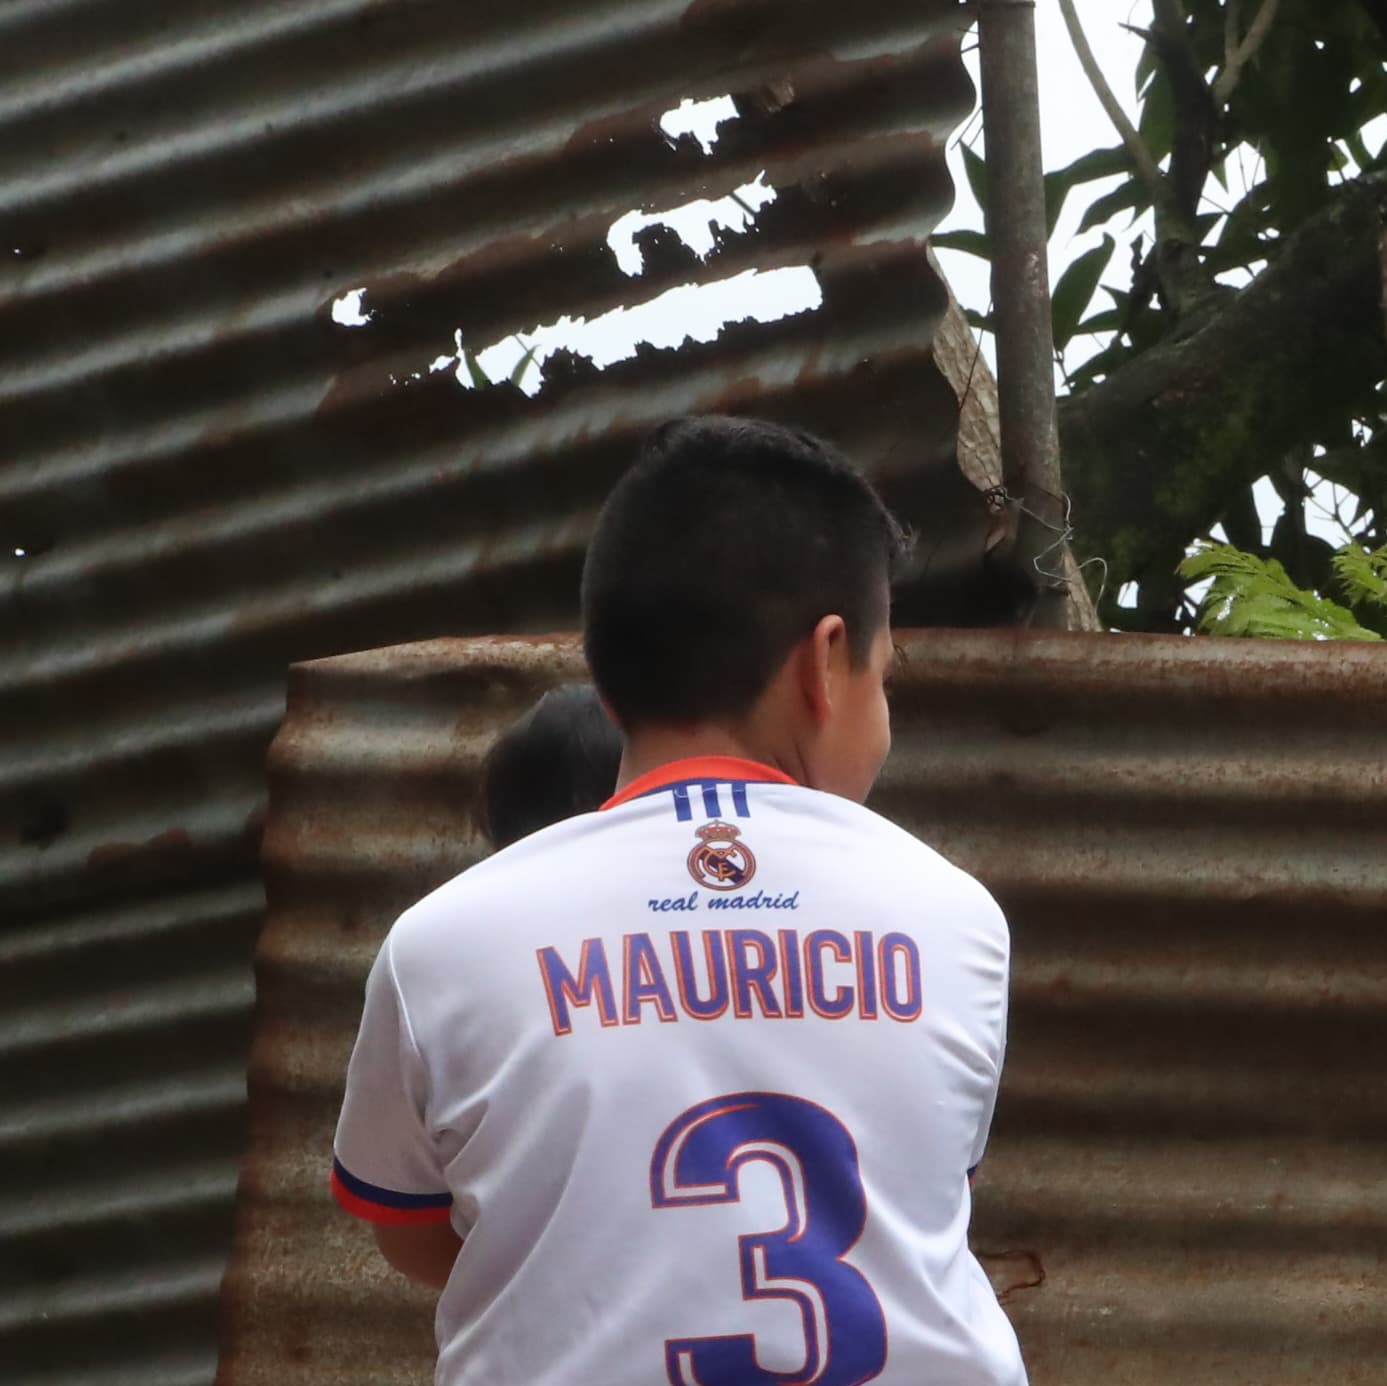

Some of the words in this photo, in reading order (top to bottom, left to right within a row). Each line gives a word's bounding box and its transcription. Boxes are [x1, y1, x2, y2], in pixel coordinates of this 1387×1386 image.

[648, 891, 699, 912] real
[707, 890, 800, 911] madrid
[536, 929, 923, 1037] MAURICIO
